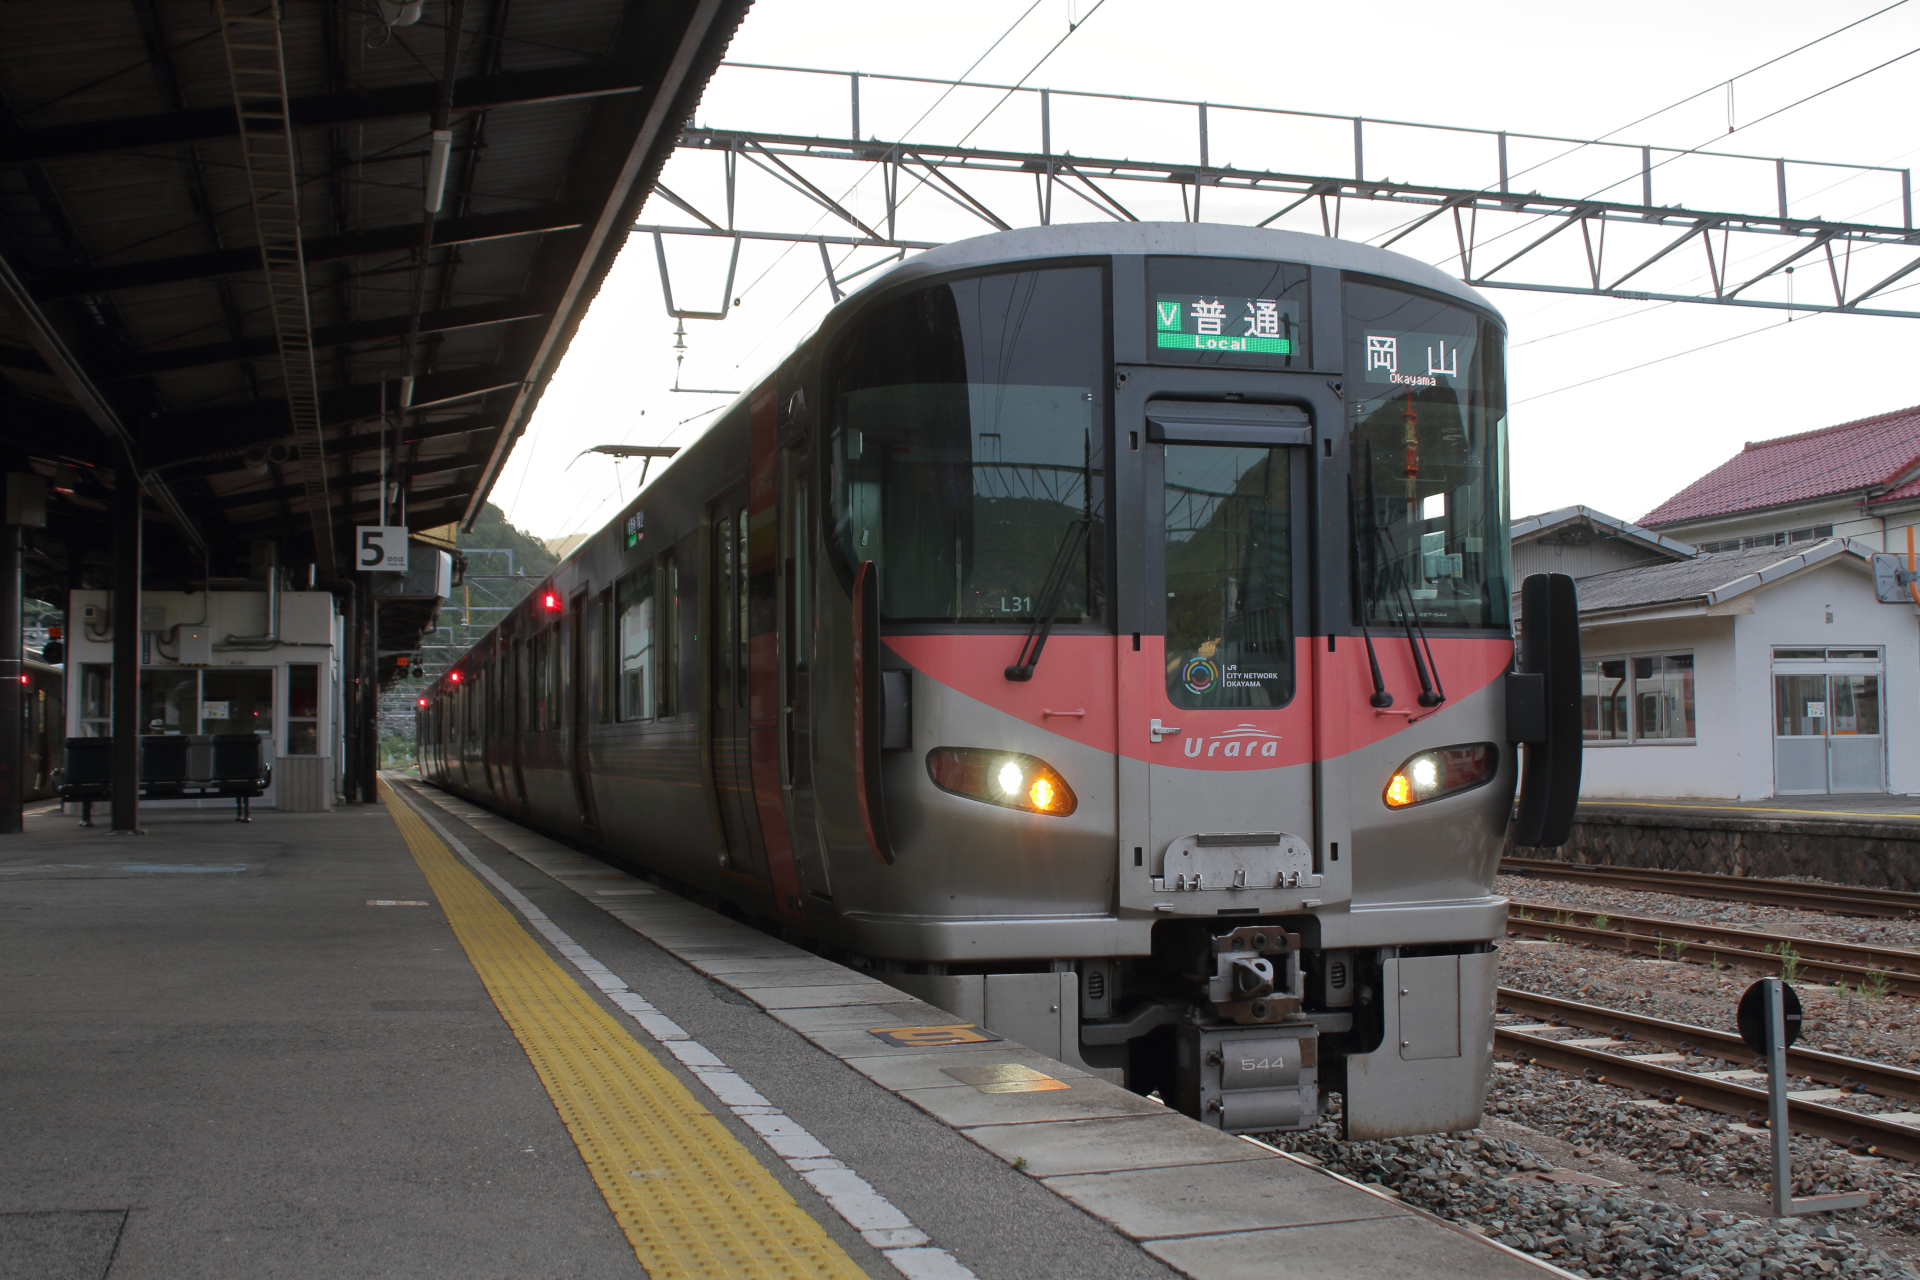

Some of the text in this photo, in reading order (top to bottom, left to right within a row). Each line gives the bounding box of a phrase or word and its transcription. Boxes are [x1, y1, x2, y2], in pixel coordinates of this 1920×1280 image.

[1158, 304, 1178, 326] V
[1190, 295, 1281, 338] 普通
[1195, 335, 1246, 350] Local
[1367, 335, 1457, 378] 岡山
[1389, 372, 1437, 387] Okayama
[361, 531, 384, 566] 5
[1001, 596, 1030, 612] L31
[1184, 737, 1278, 758] Urara
[1241, 1057, 1285, 1071] 544
